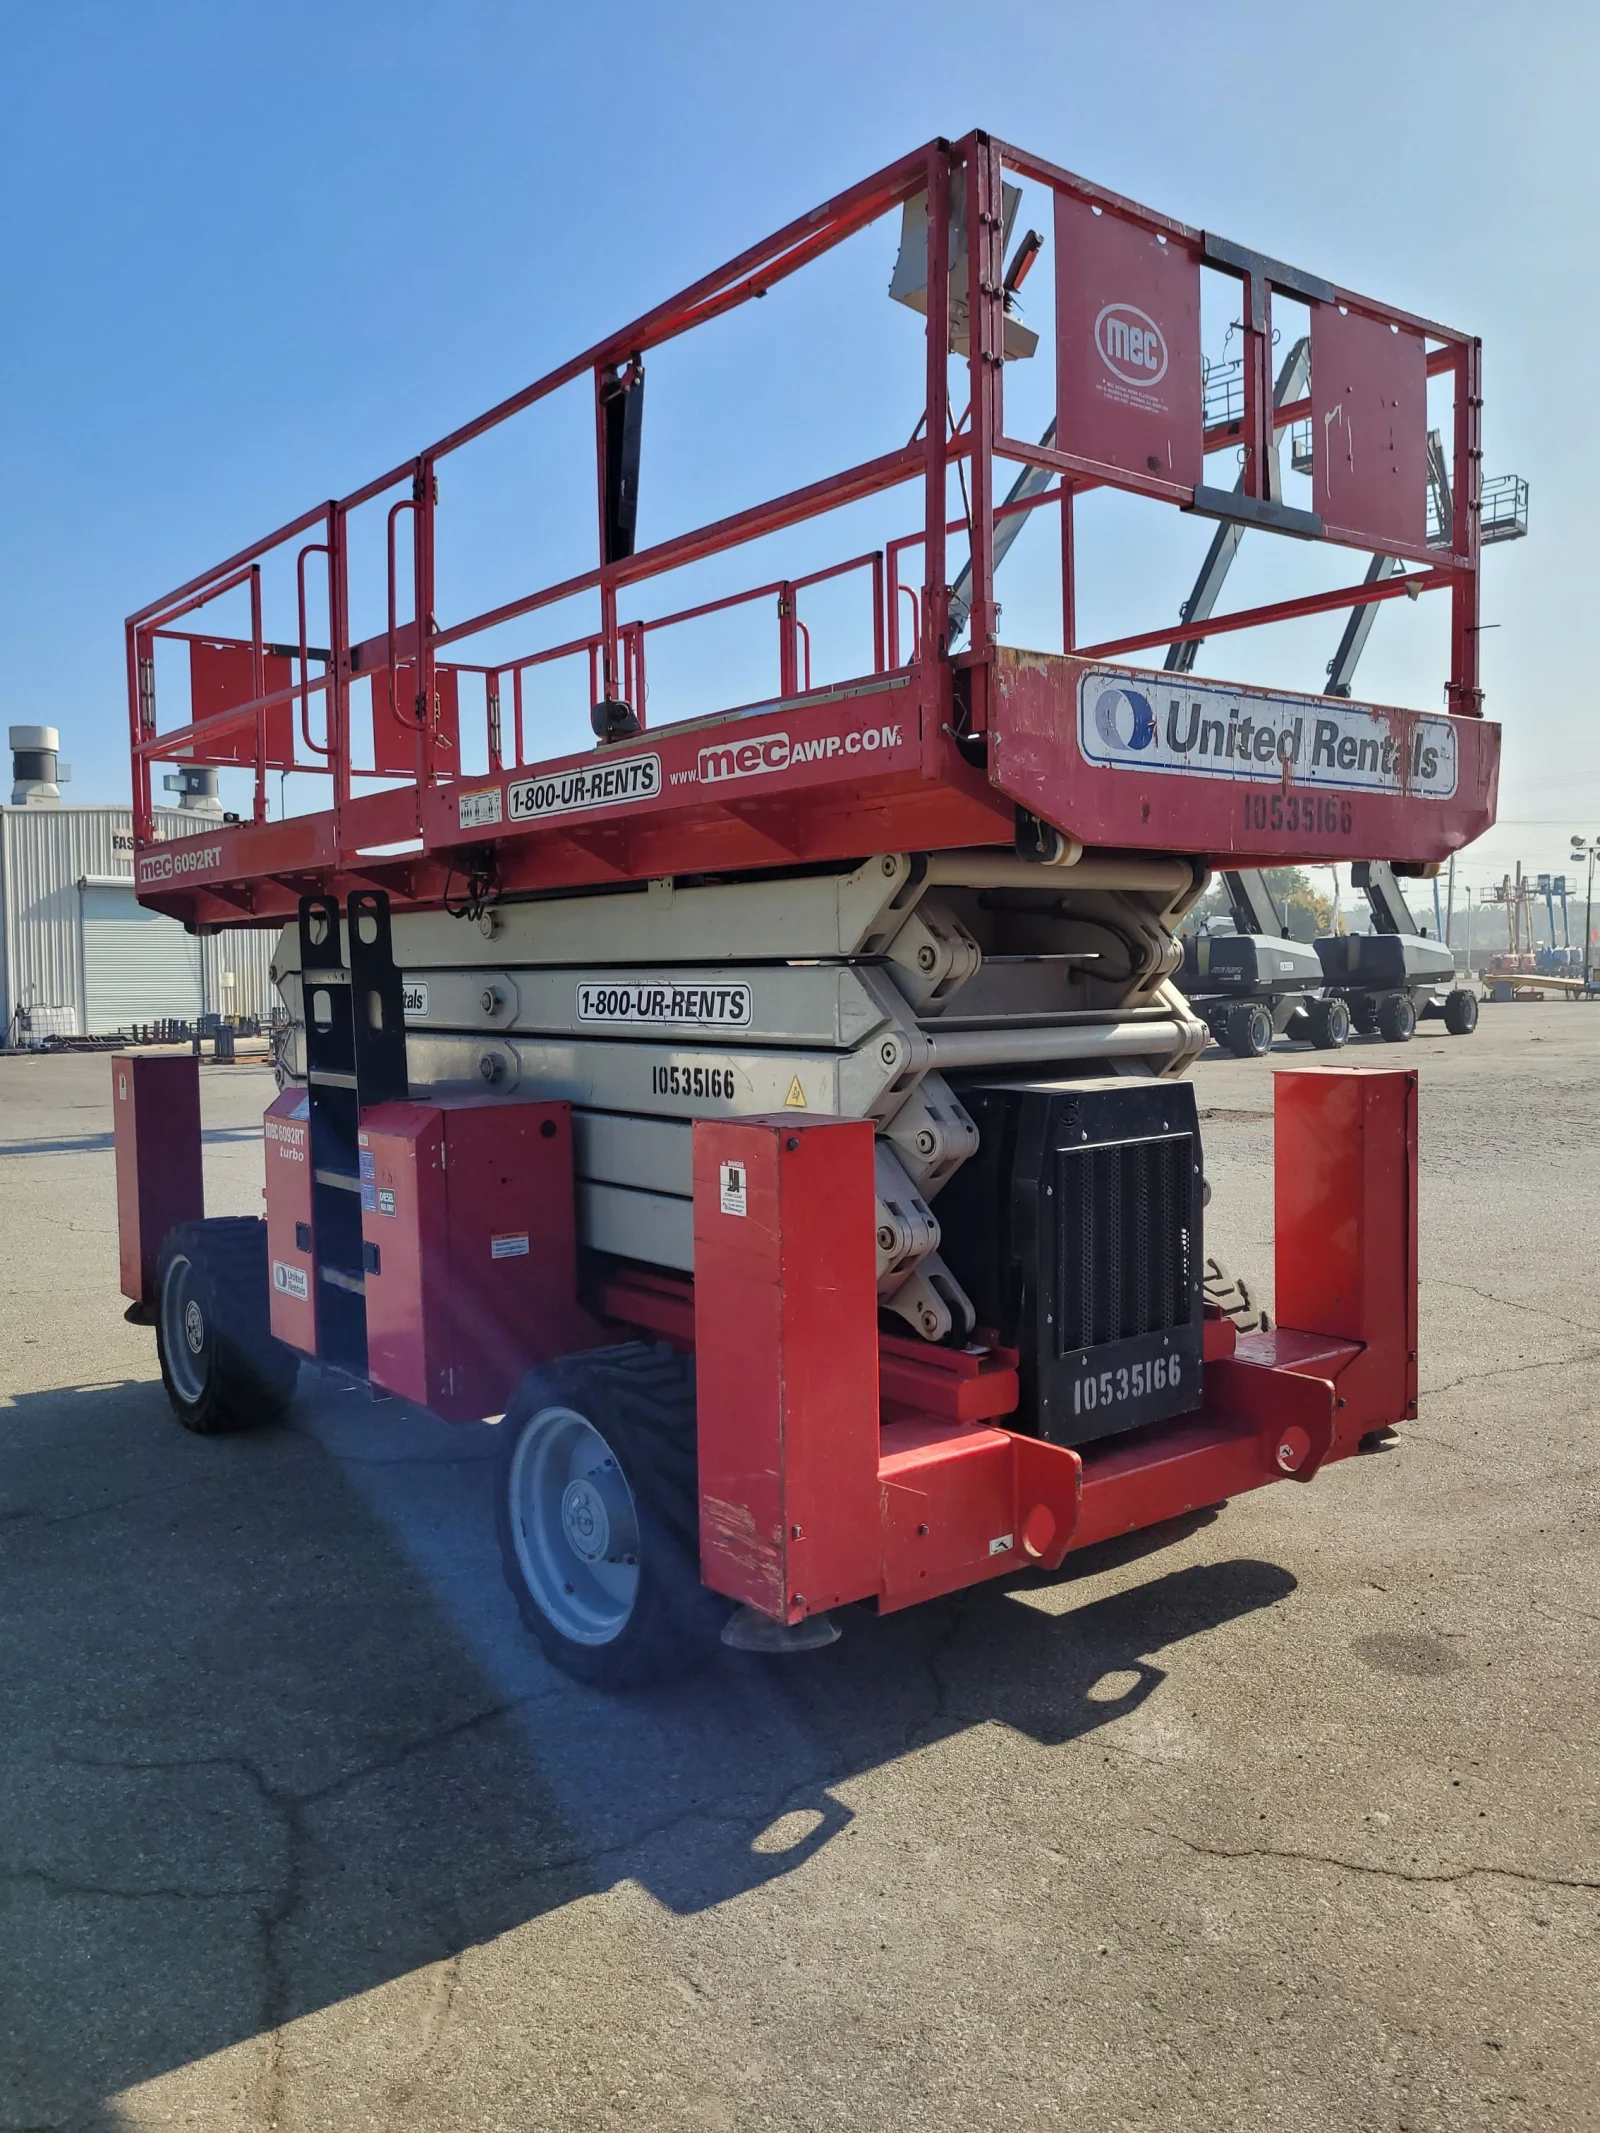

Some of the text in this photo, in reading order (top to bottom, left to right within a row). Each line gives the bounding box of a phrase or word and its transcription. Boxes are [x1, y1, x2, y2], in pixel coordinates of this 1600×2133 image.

[1166, 700, 1303, 765] United
[512, 762, 654, 813] 1-800-UR-RENTS
[1244, 793, 1353, 835] 10535166
[174, 846, 222, 874] 6092RT
[582, 990, 745, 1019] 1-800-UR-RENTS
[653, 1065, 735, 1100] 10535166
[279, 1125, 305, 1146] 6092RT
[280, 1145, 304, 1162] turbo
[287, 1269, 304, 1284] United
[287, 1281, 306, 1296] Rentals
[1074, 1353, 1181, 1415] 10535166
